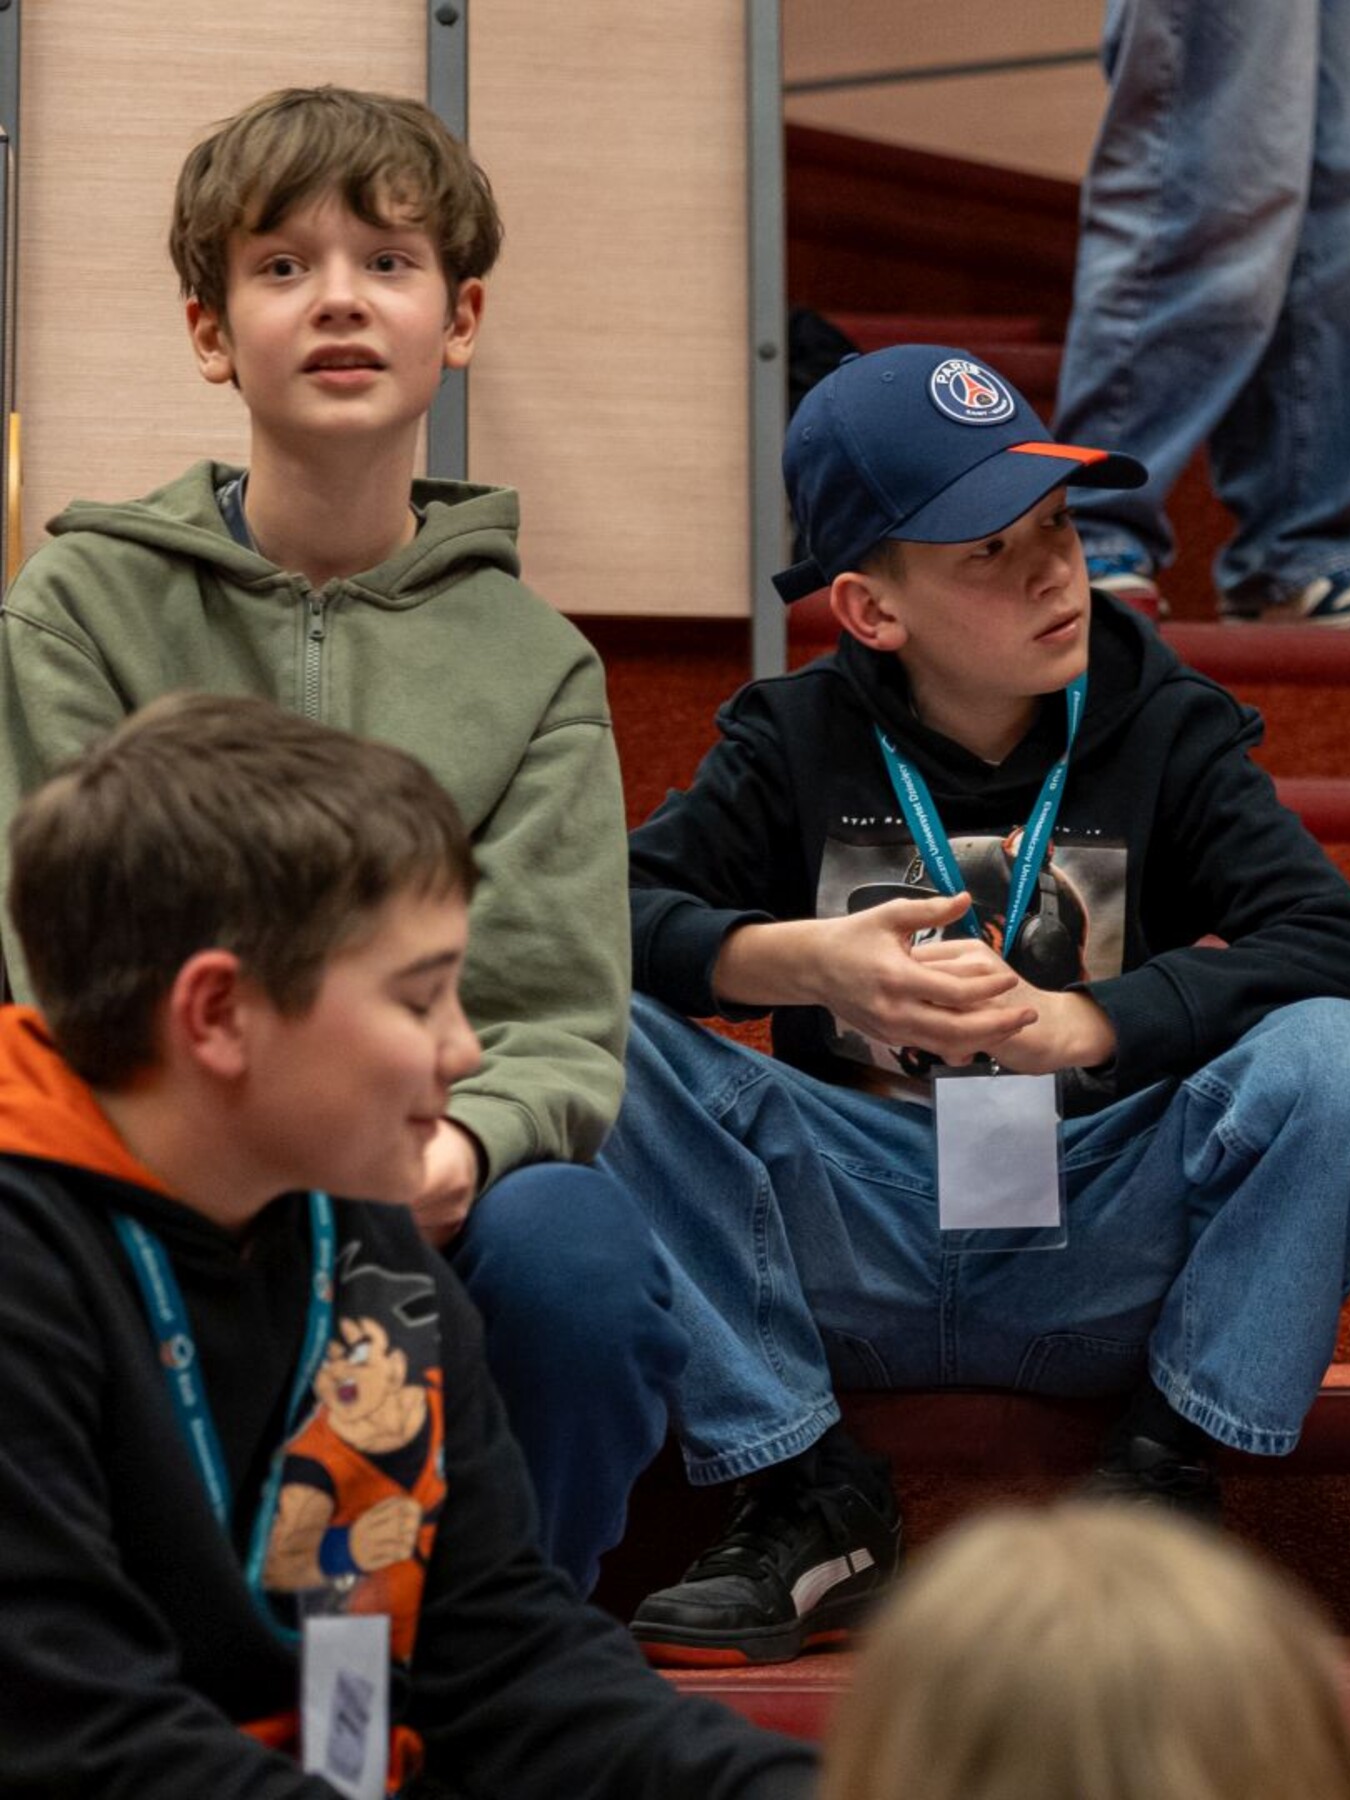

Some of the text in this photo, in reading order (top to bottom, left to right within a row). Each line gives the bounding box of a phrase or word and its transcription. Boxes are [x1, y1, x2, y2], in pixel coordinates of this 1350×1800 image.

[936, 362, 981, 384] PARIS
[913, 800, 936, 857] Uniwersytet
[1006, 800, 1053, 925] Ekonomiczny Uniwersytet
